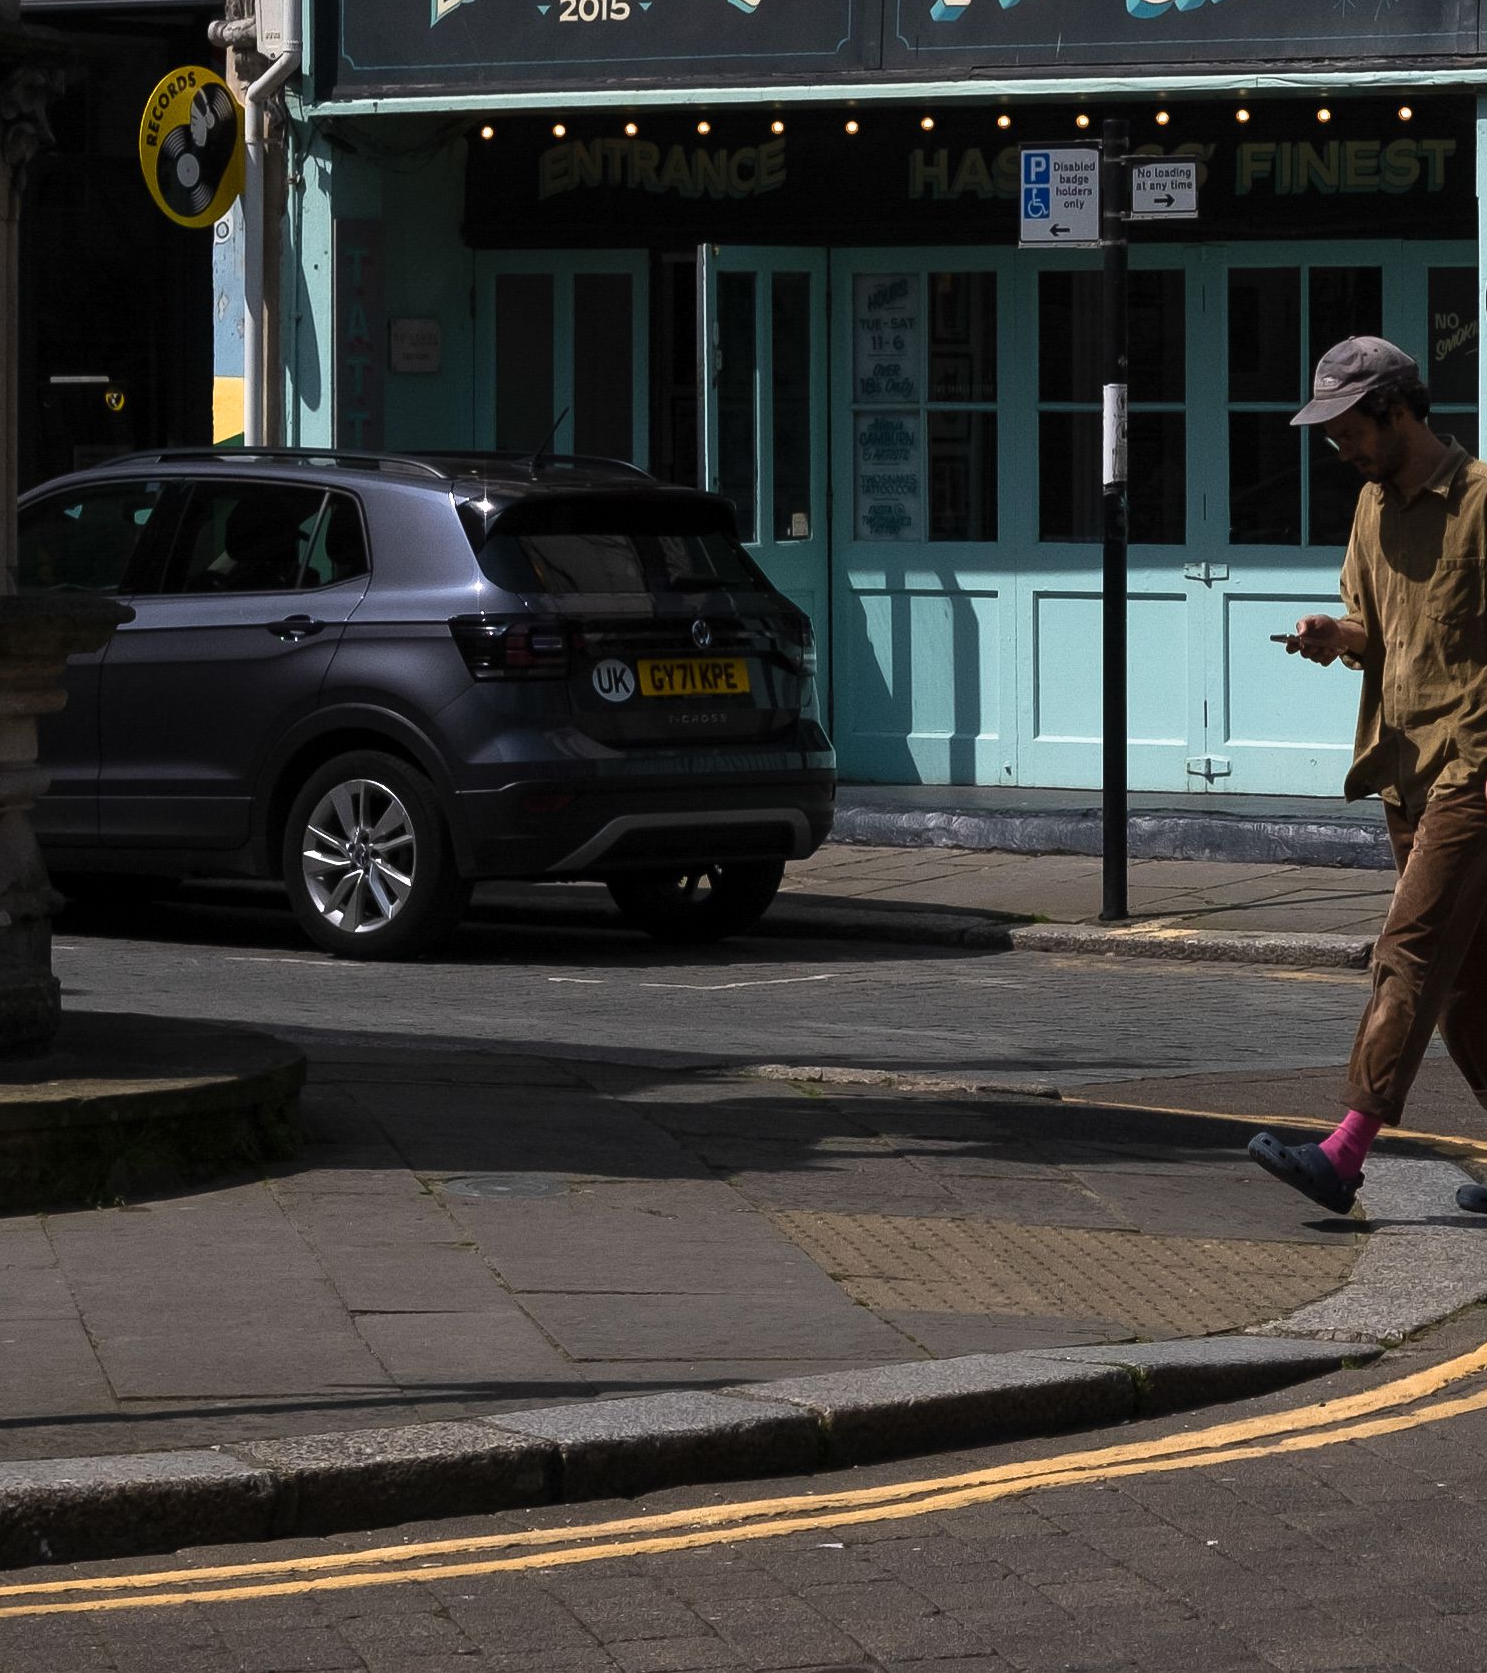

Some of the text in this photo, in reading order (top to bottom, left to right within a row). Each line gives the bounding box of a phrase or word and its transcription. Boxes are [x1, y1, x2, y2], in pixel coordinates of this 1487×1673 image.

[146, 70, 197, 147] RECORDS
[538, 134, 788, 199] ENTRANCE
[1053, 161, 1096, 172] Disabled
[1137, 167, 1192, 179] No loading
[1234, 139, 1457, 196] FINEST
[1059, 174, 1090, 185] badge
[1136, 179, 1193, 192] at any time
[1055, 187, 1093, 196] holders
[1063, 199, 1085, 210] only
[1434, 312, 1460, 330] NO
[596, 667, 630, 694] UK
[649, 662, 738, 691] GY71 KPE
[668, 714, 729, 724] T-CROSS
